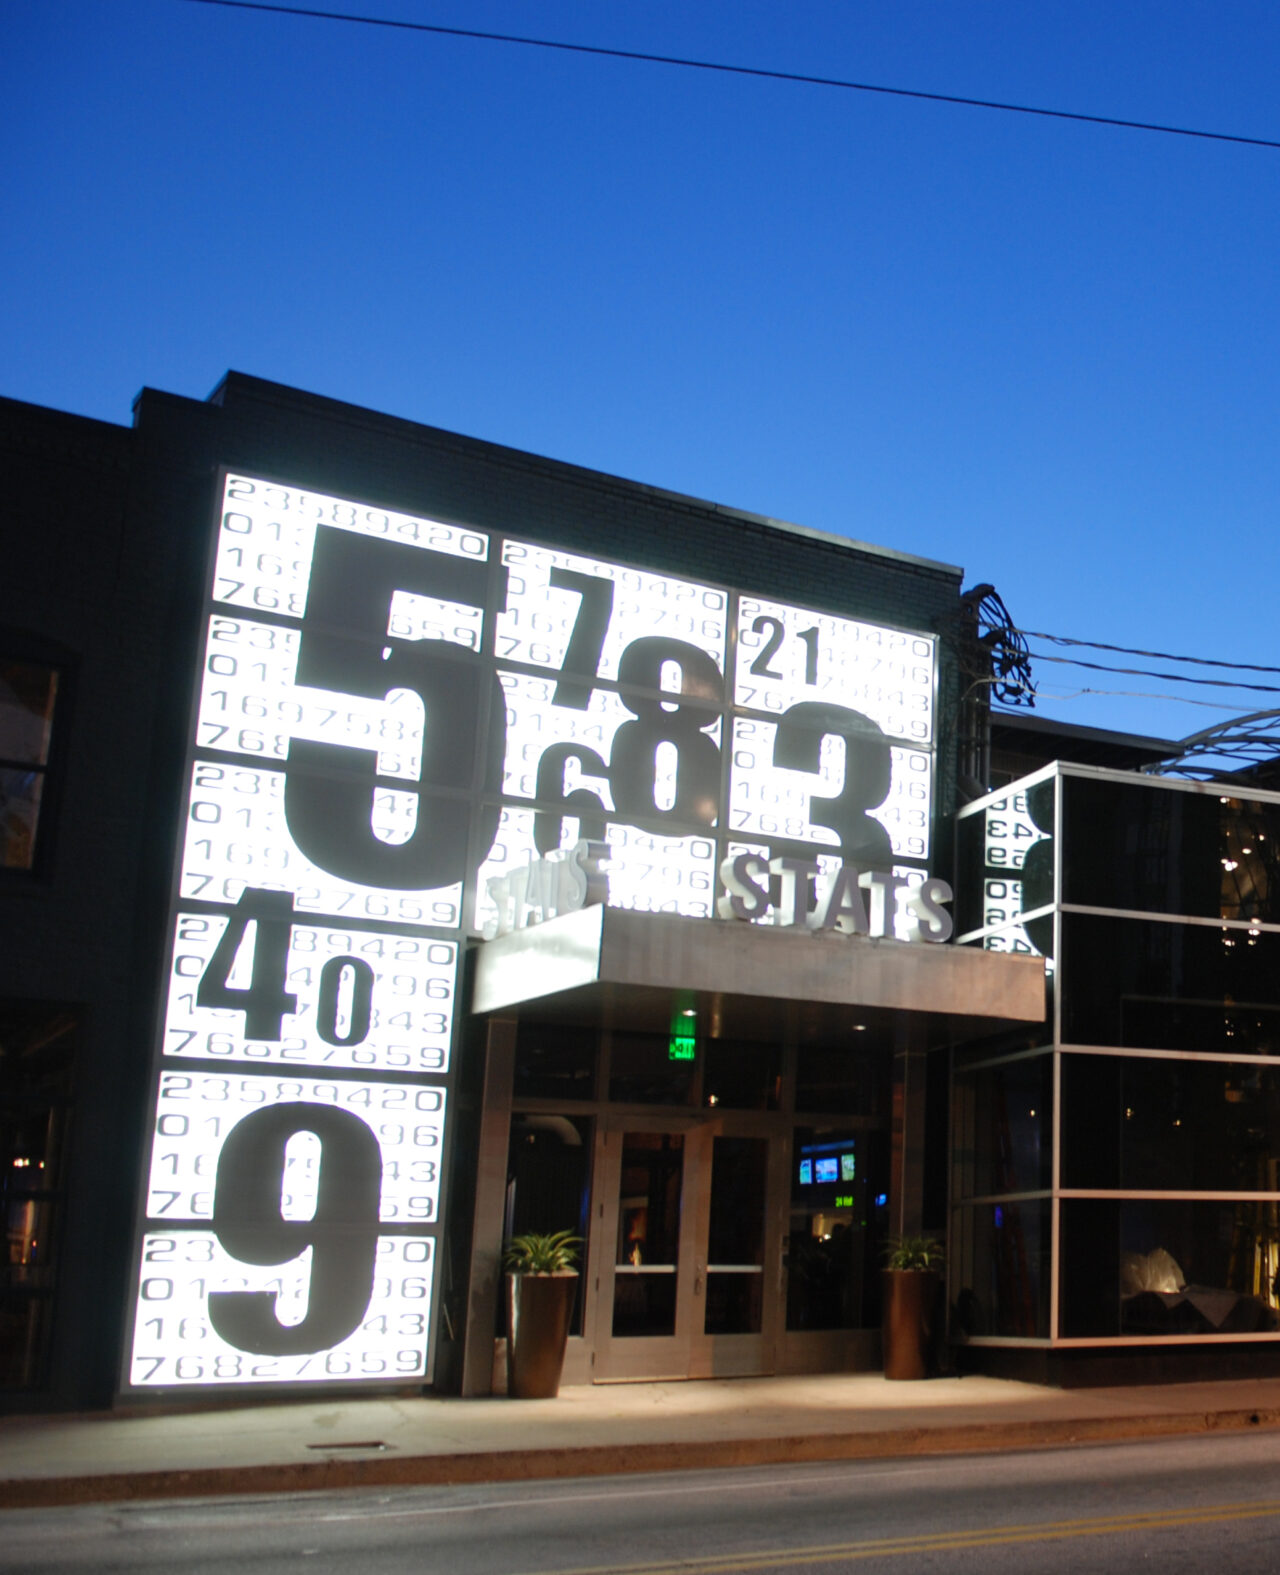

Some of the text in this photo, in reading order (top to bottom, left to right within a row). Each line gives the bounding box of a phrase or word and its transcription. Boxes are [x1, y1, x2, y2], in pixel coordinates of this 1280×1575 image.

[285, 523, 509, 891] 5
[550, 565, 614, 711] 7
[750, 615, 820, 686] 21
[609, 635, 725, 838] 8
[719, 852, 954, 943] STATS
[207, 1101, 383, 1357] 9
